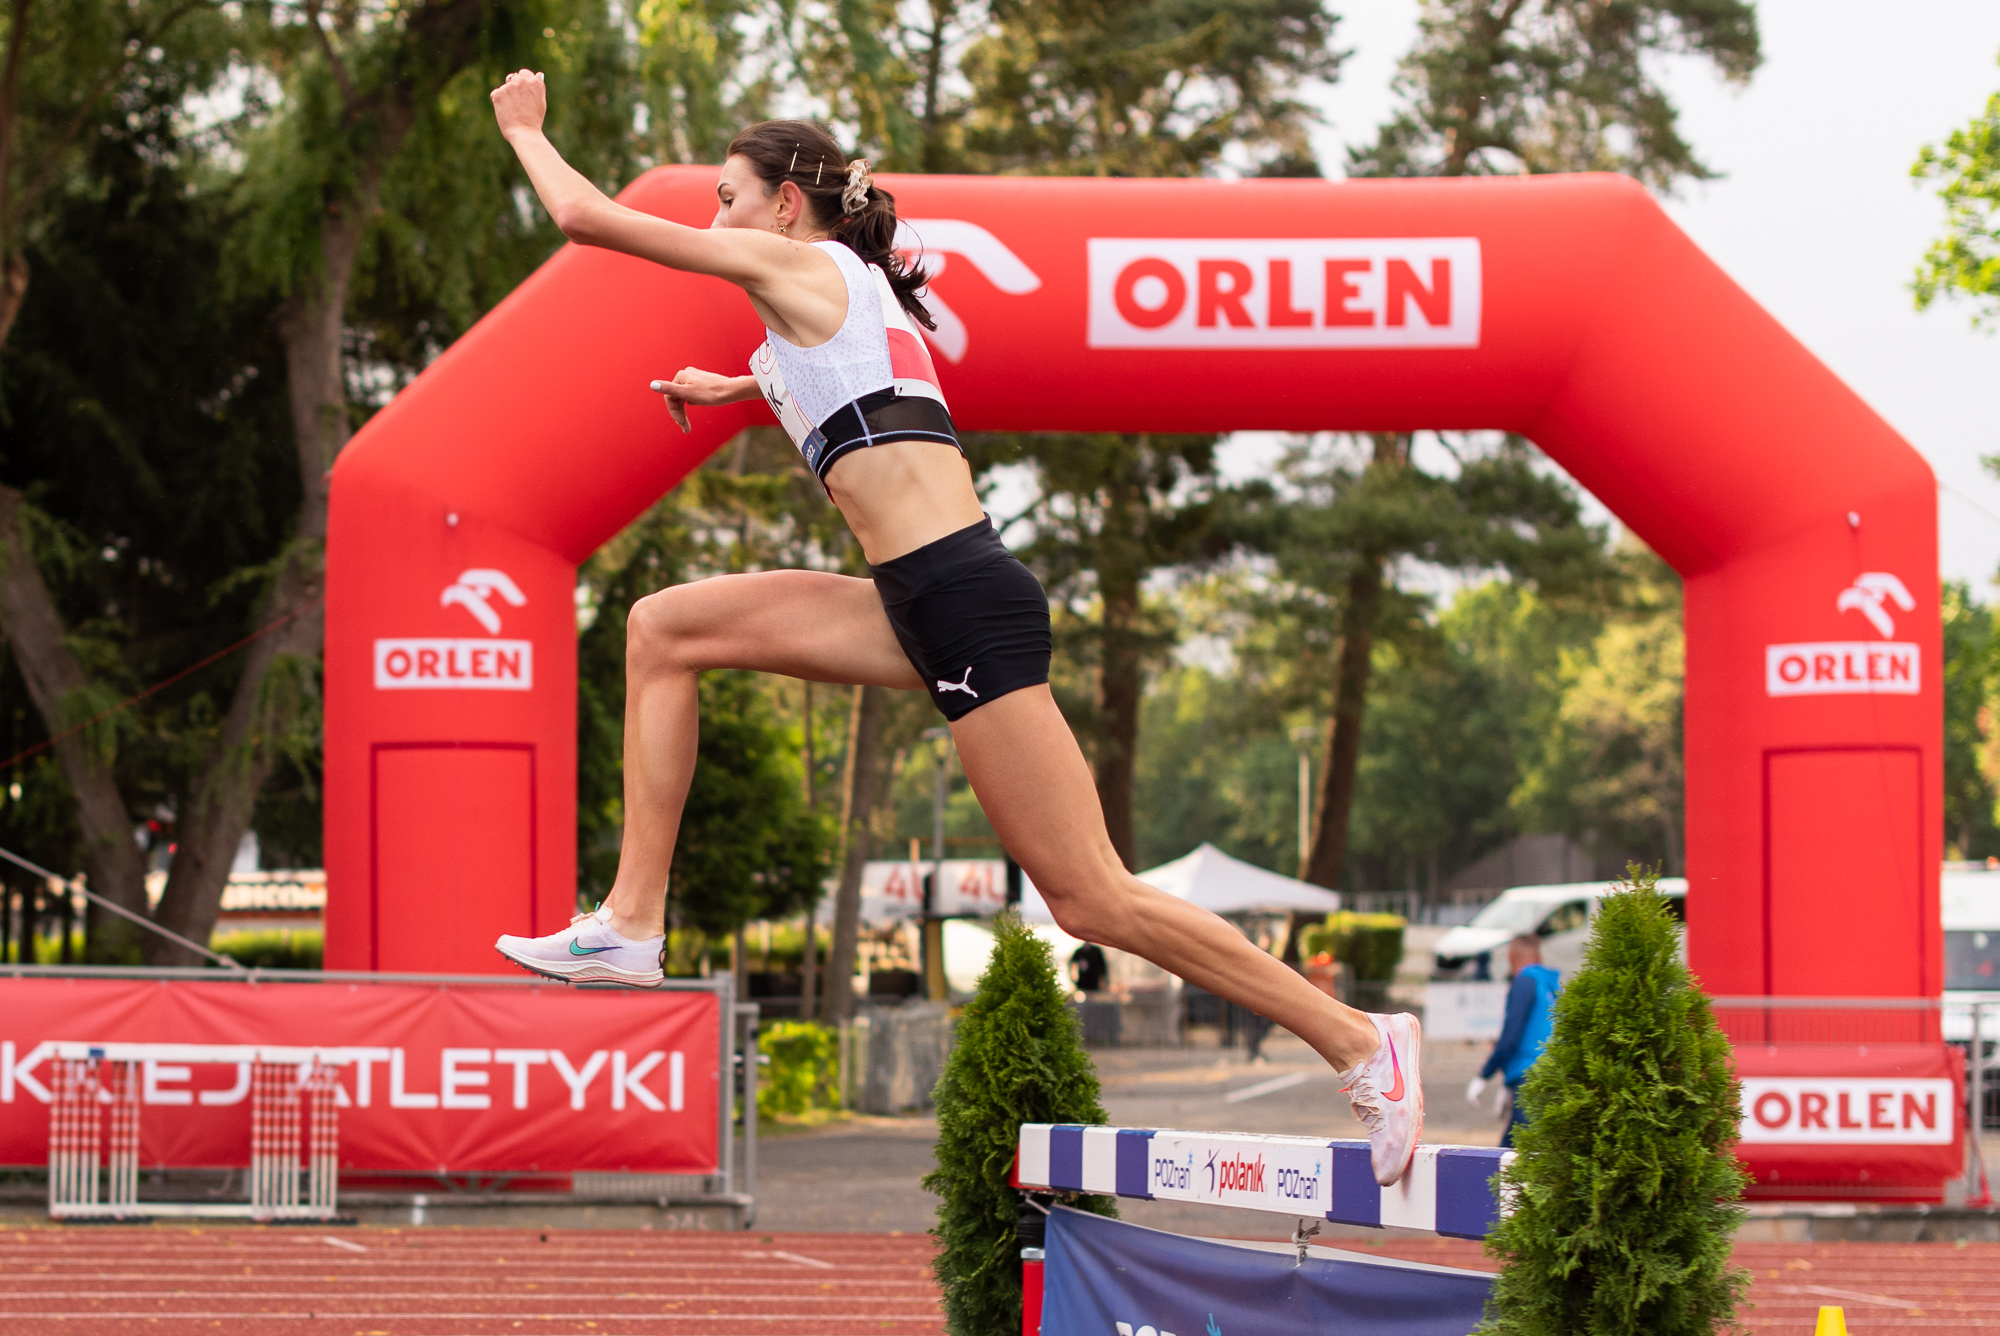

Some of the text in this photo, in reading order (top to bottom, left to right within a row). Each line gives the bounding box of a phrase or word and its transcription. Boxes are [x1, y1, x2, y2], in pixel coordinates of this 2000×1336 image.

[1113, 255, 1454, 330] ORLEN
[385, 648, 521, 679] ORLEN
[1779, 653, 1910, 683] ORLEN
[1753, 1091, 1937, 1130] ORLEN
[1218, 1151, 1266, 1199] polanik
